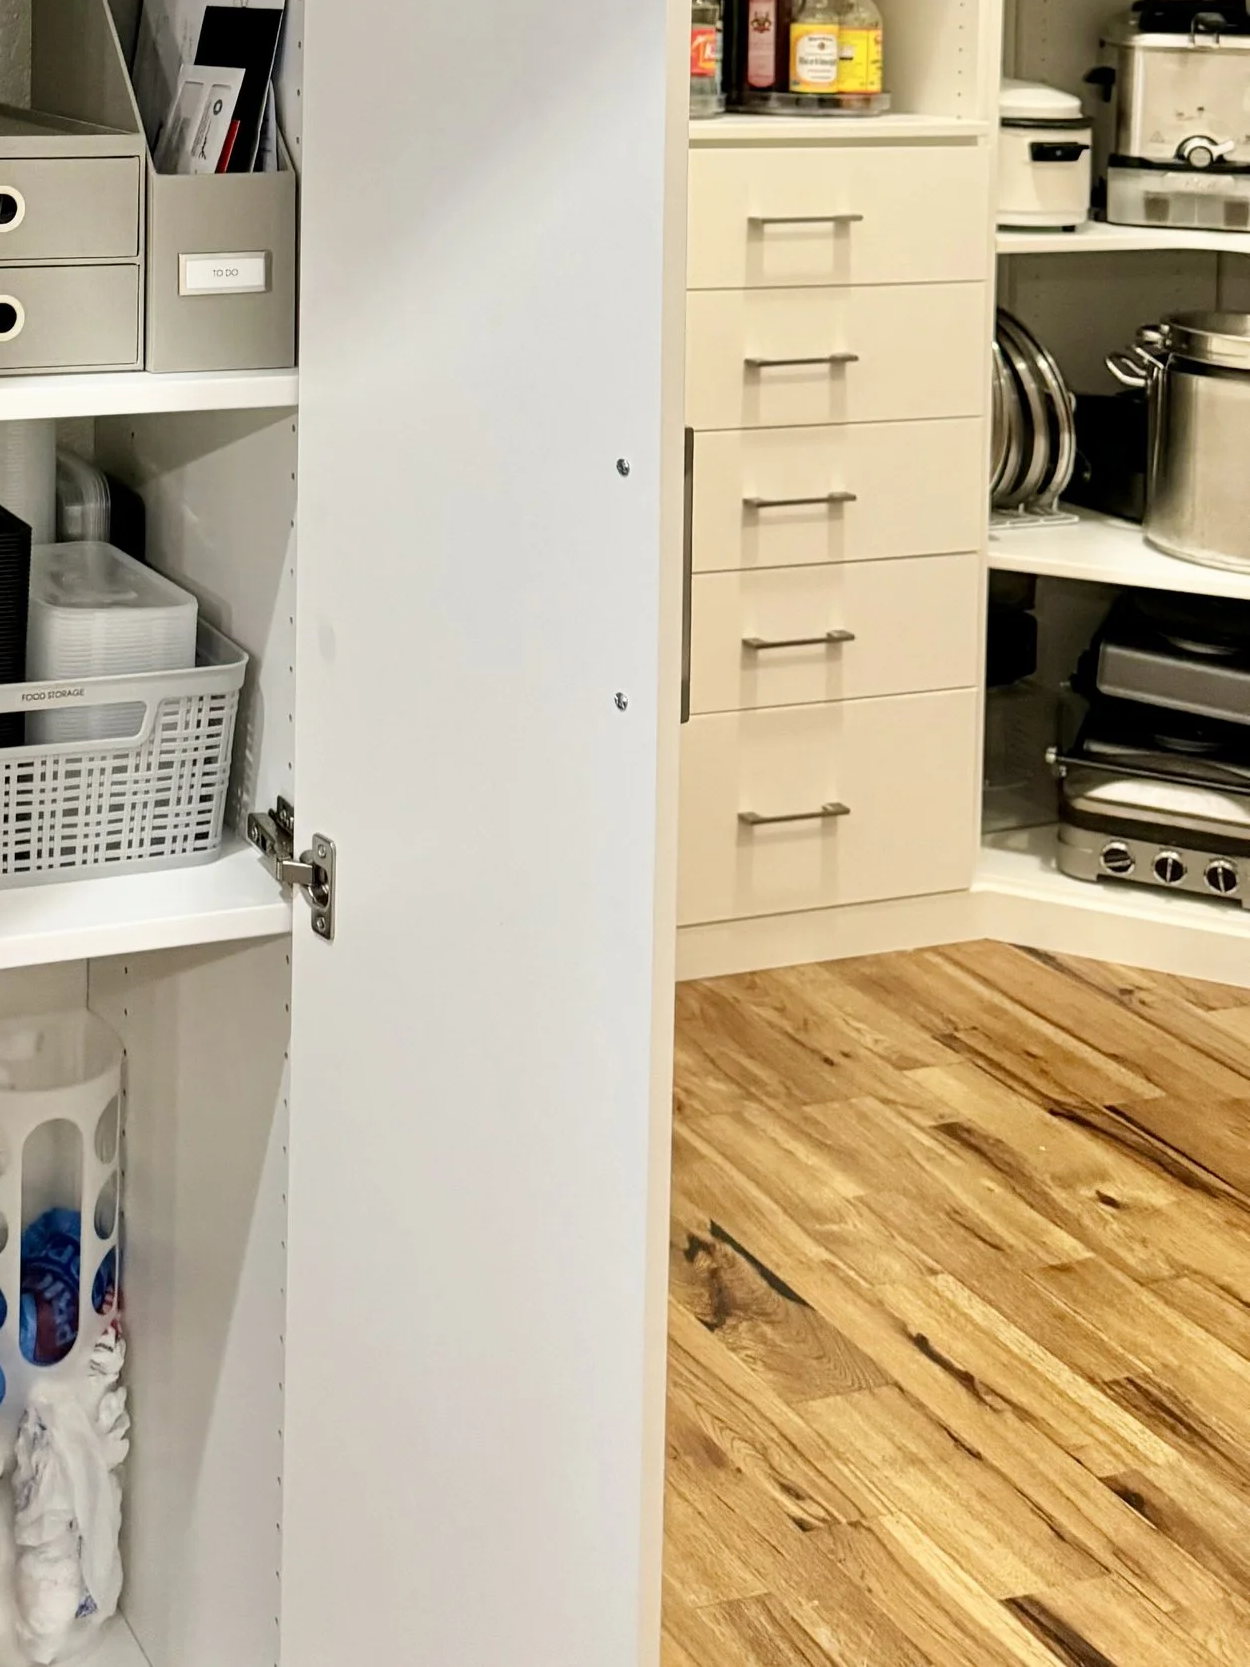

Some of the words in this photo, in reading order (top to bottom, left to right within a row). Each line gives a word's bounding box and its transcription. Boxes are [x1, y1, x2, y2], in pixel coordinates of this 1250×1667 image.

[212, 269, 224, 277] TO
[225, 268, 239, 277] DO
[22, 692, 46, 702] FOOD
[47, 688, 85, 699] STORAGE
